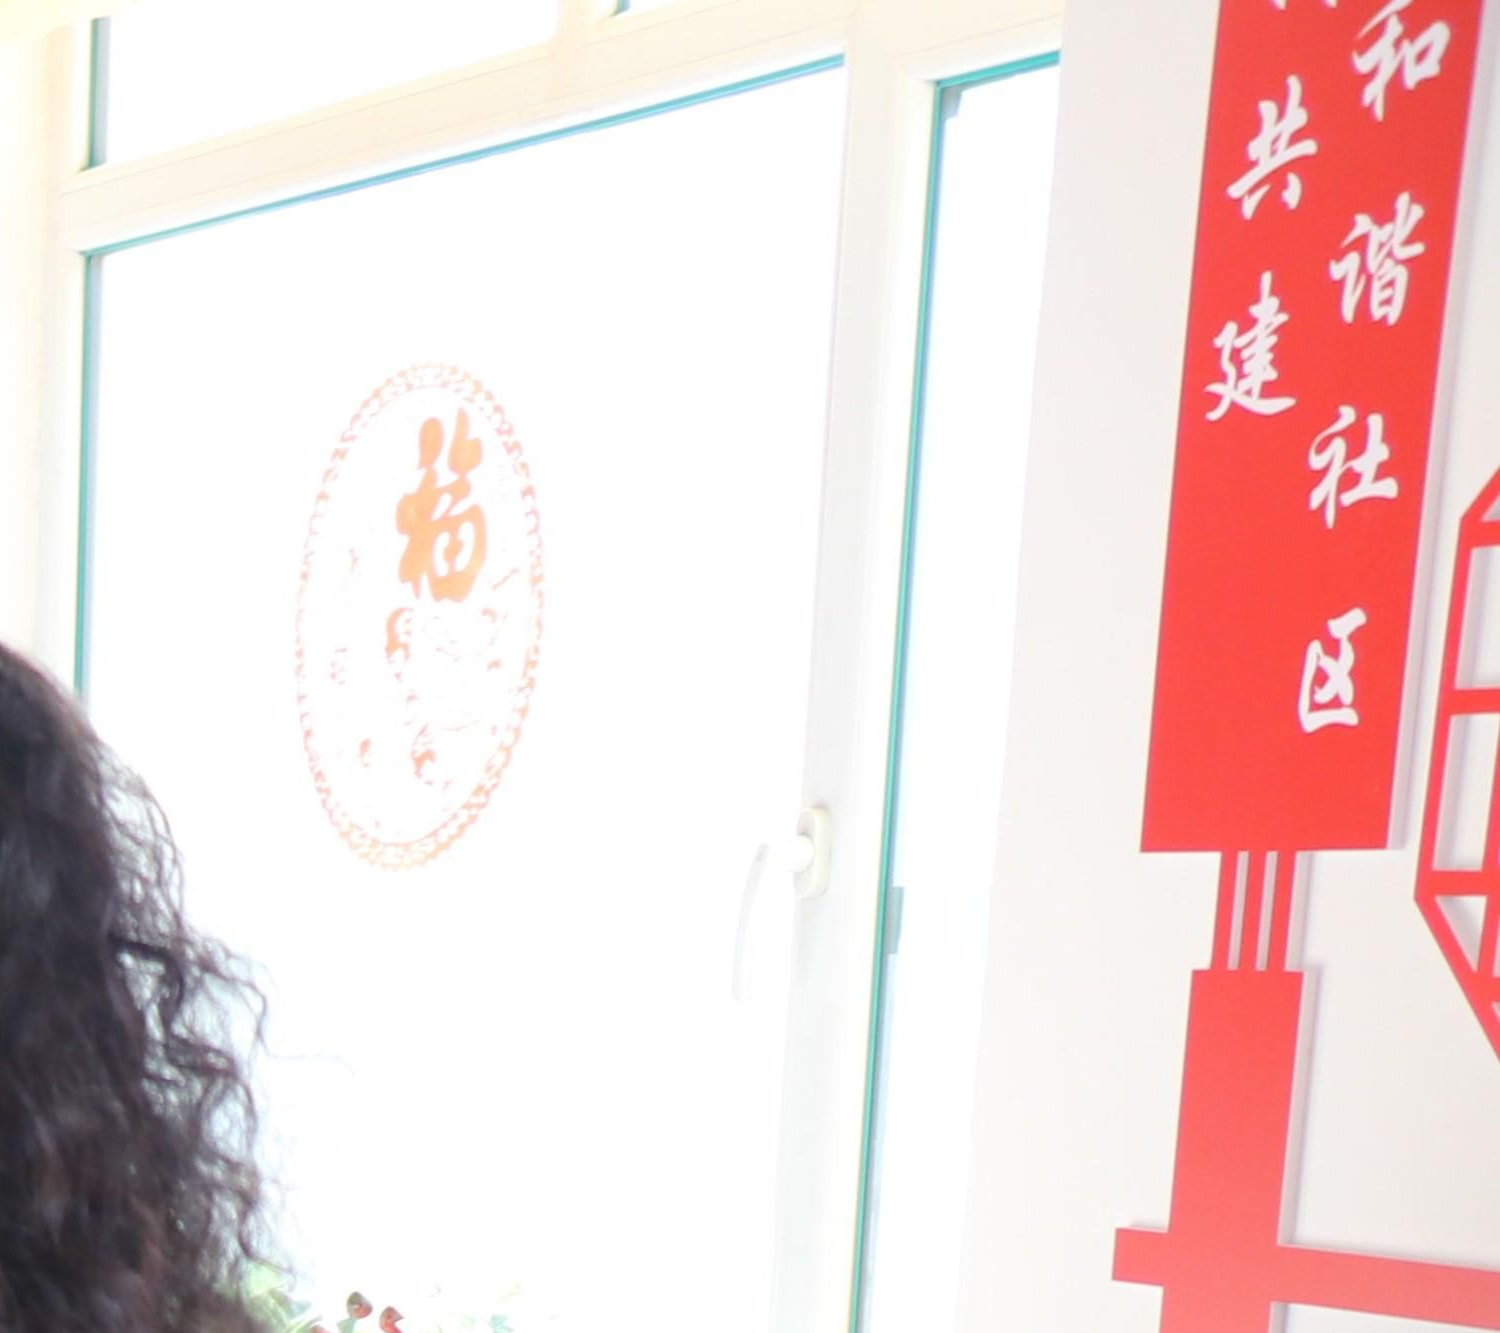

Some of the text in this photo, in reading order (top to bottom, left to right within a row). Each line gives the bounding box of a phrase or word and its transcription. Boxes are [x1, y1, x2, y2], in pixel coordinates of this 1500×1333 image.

[1204, 0, 1337, 422] 共建
[1297, 0, 1451, 734] 和谐社区
